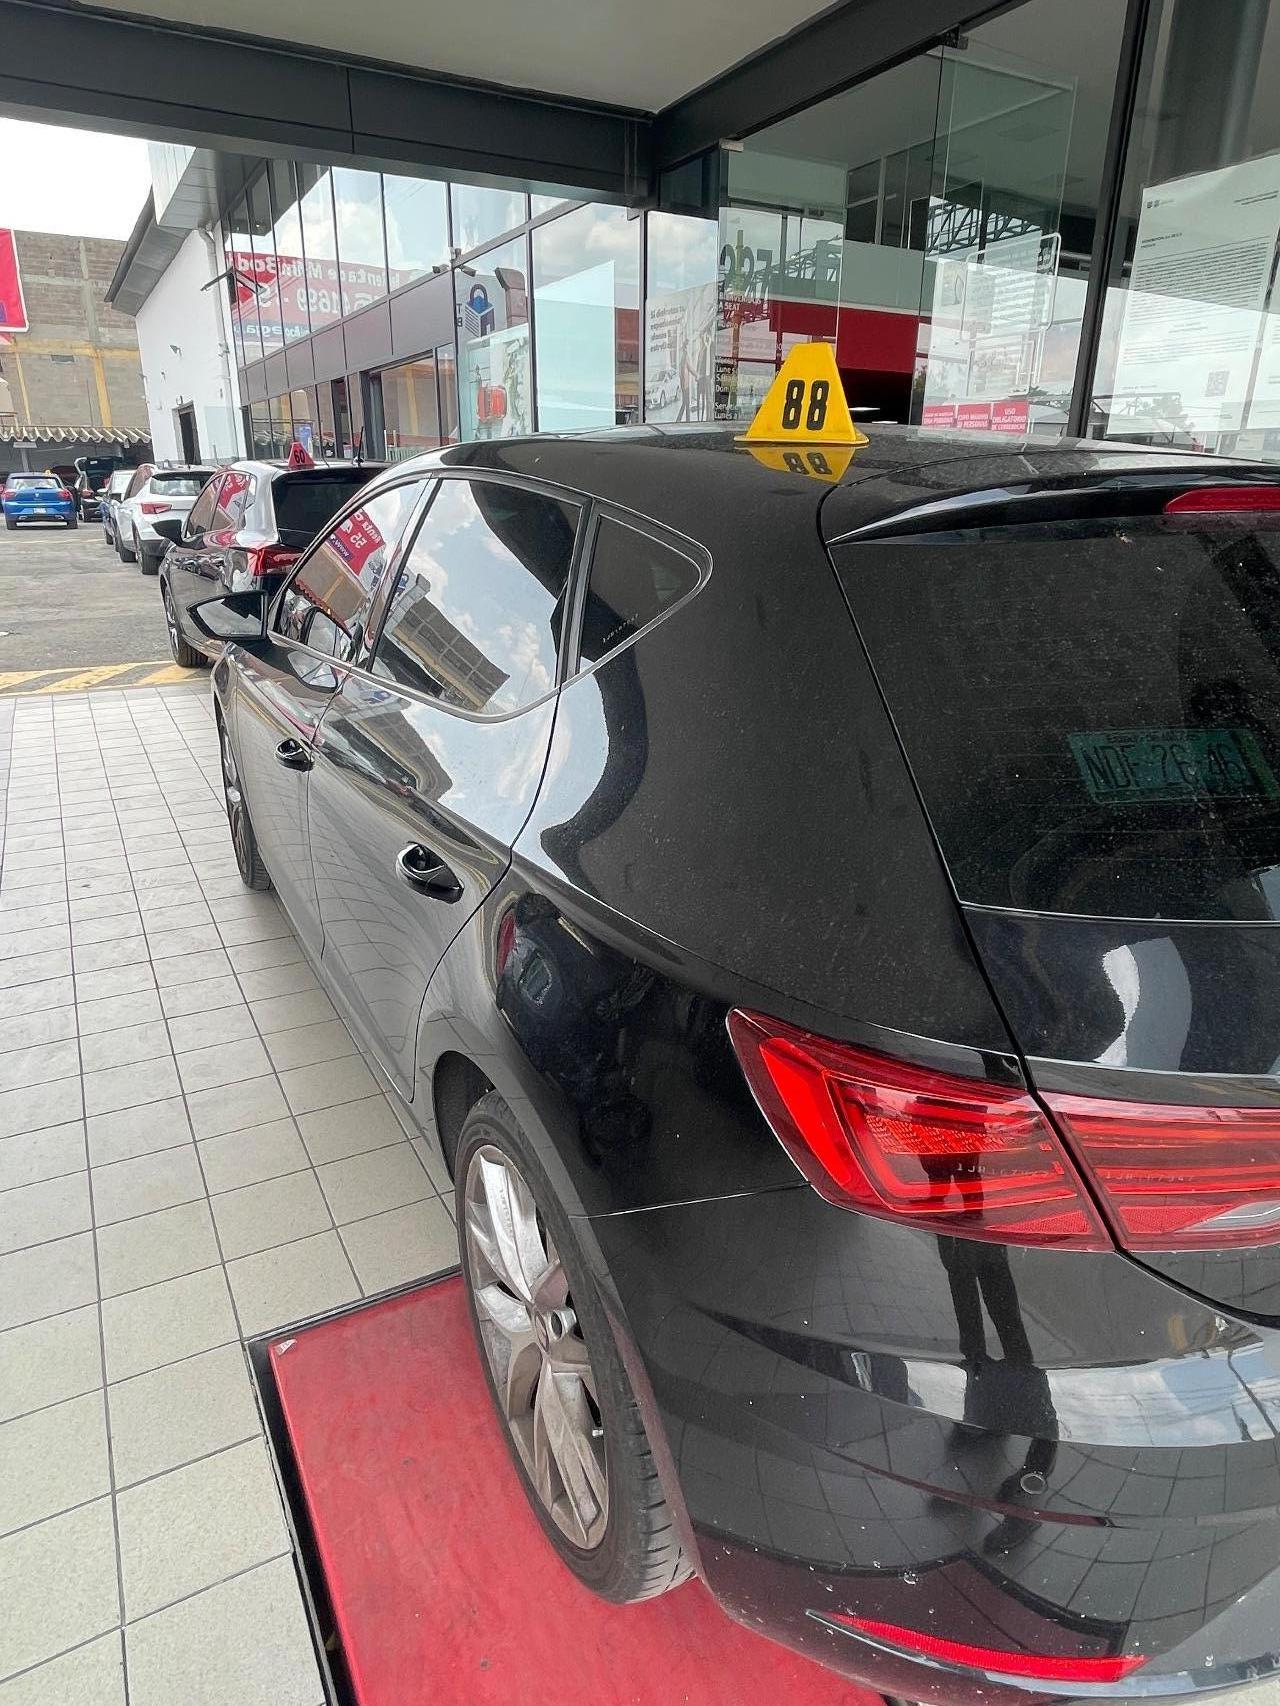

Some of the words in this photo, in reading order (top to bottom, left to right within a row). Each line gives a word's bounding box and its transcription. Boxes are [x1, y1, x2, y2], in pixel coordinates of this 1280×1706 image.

[724, 302, 741, 311] SEAT
[782, 379, 830, 431] 88
[1004, 407, 1016, 415] USO
[294, 450, 306, 464] 60
